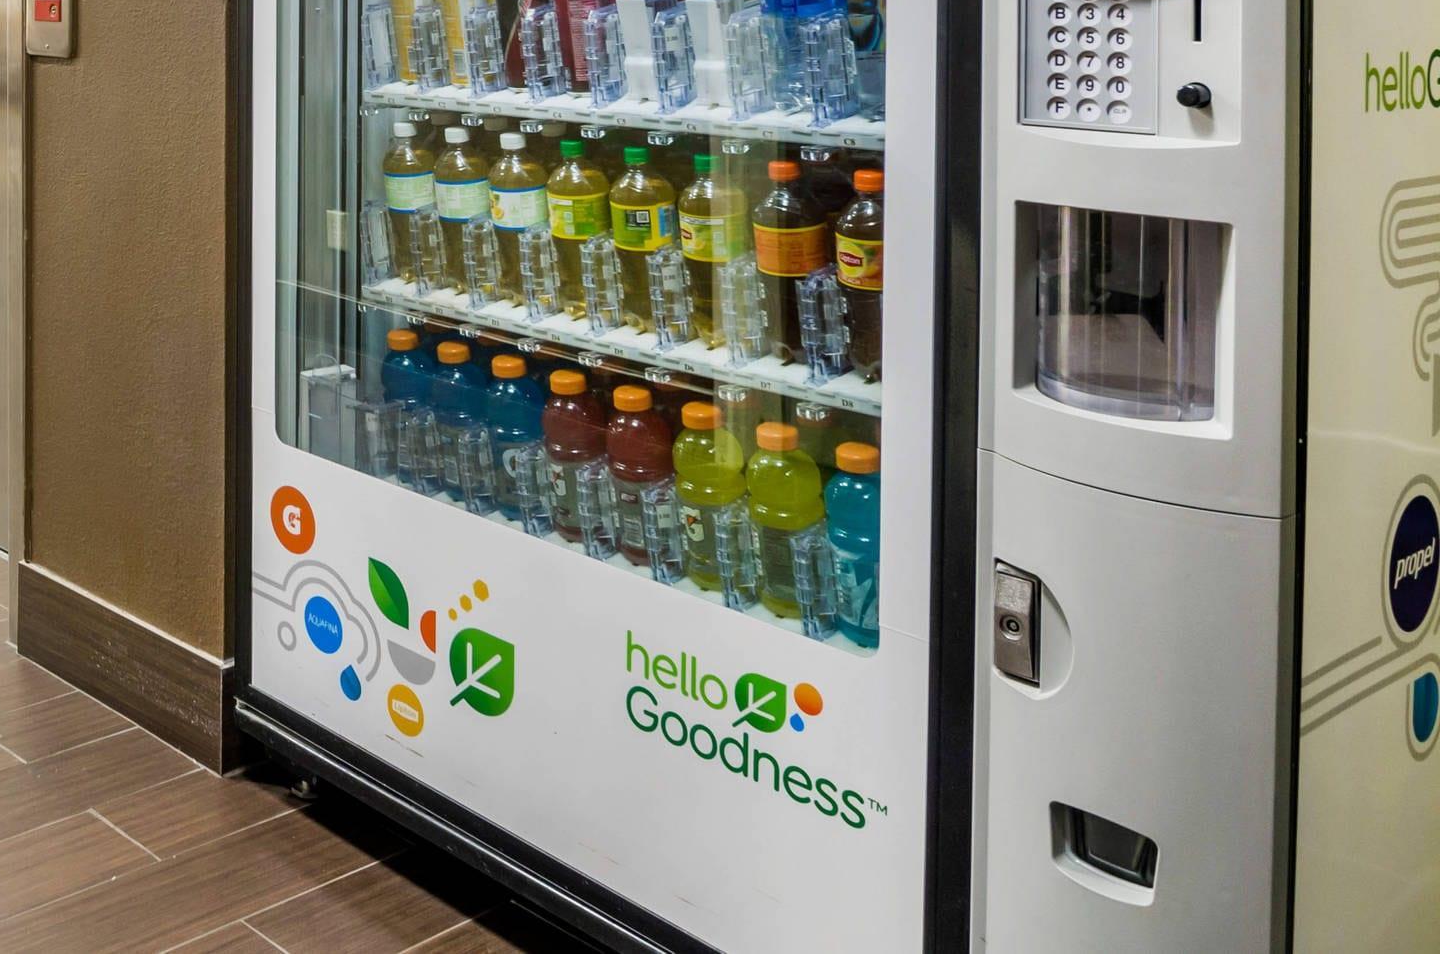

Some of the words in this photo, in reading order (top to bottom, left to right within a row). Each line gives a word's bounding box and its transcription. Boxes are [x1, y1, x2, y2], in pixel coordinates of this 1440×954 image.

[1055, 8, 1066, 19] B
[1086, 8, 1095, 20] 3
[1116, 8, 1125, 20] 4
[1055, 31, 1066, 43] C
[1086, 32, 1095, 44] 5
[1116, 32, 1125, 45] 6
[1055, 54, 1066, 66] D
[1086, 56, 1094, 67] 7
[1116, 56, 1125, 69] 8
[1055, 78, 1065, 90] E
[1085, 79, 1095, 92] 9
[1116, 80, 1125, 93] 0
[1055, 101, 1065, 113] F
[762, 129, 774, 139] C7
[843, 137, 856, 147] C8
[760, 380, 772, 390] D7
[841, 398, 854, 408] D8
[282, 504, 301, 536] G
[1394, 536, 1436, 590] propel
[308, 613, 339, 637] AQUAFINA
[626, 629, 728, 710] hello
[626, 685, 866, 829] Goodness
